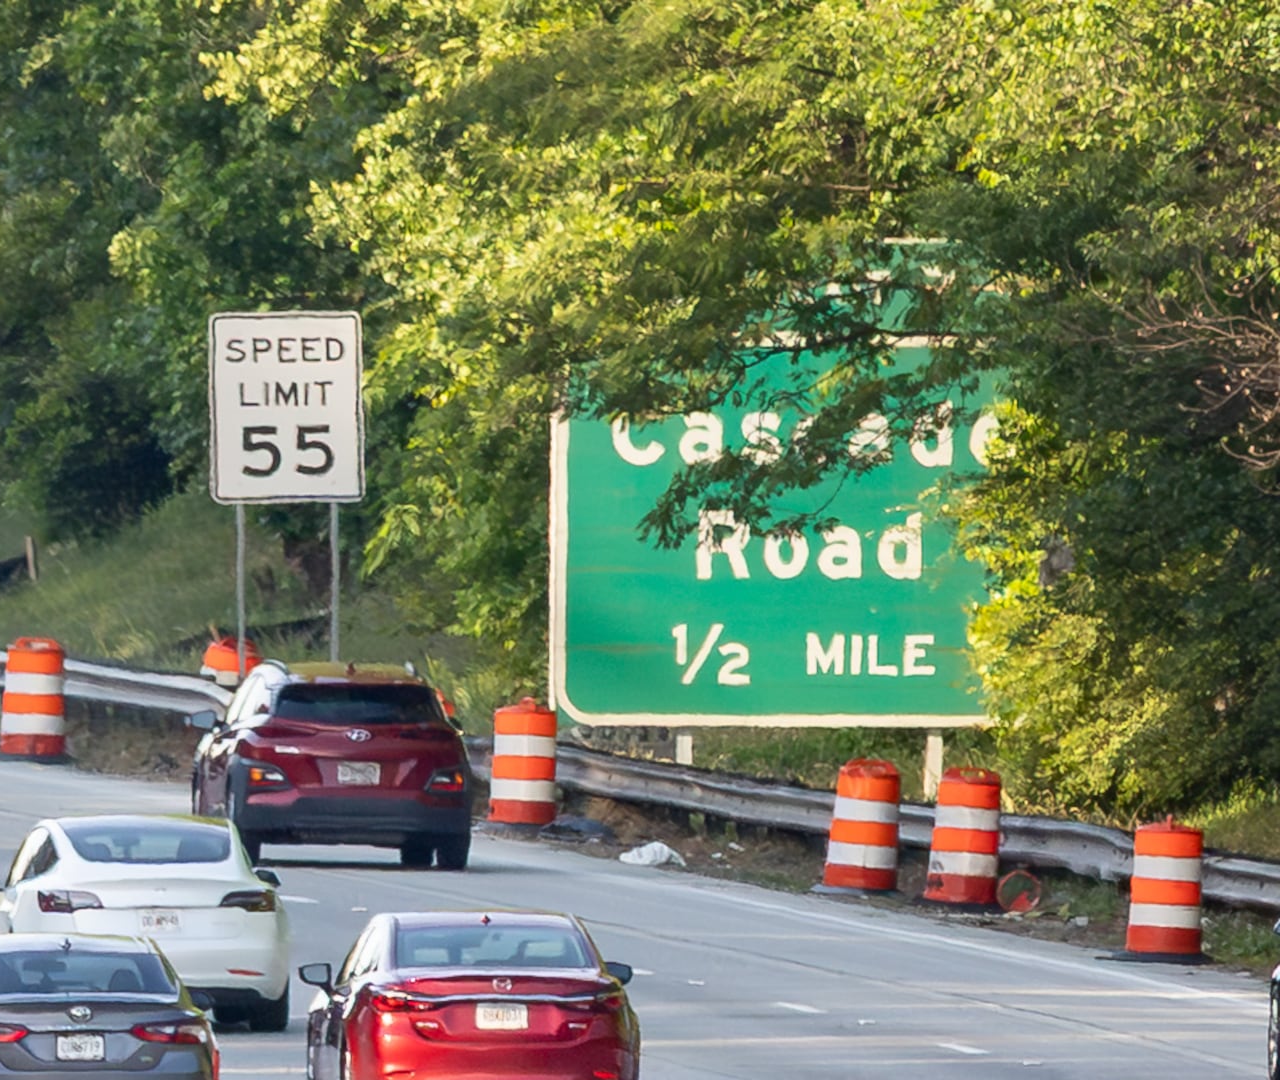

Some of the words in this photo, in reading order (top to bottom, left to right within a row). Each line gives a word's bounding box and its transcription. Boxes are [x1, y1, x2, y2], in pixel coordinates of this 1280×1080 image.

[225, 337, 344, 363] SPEED
[239, 381, 333, 407] LIMIT
[241, 424, 334, 478] 55
[696, 509, 923, 580] Road
[672, 623, 751, 685] 1/2
[806, 632, 936, 676] MILE
